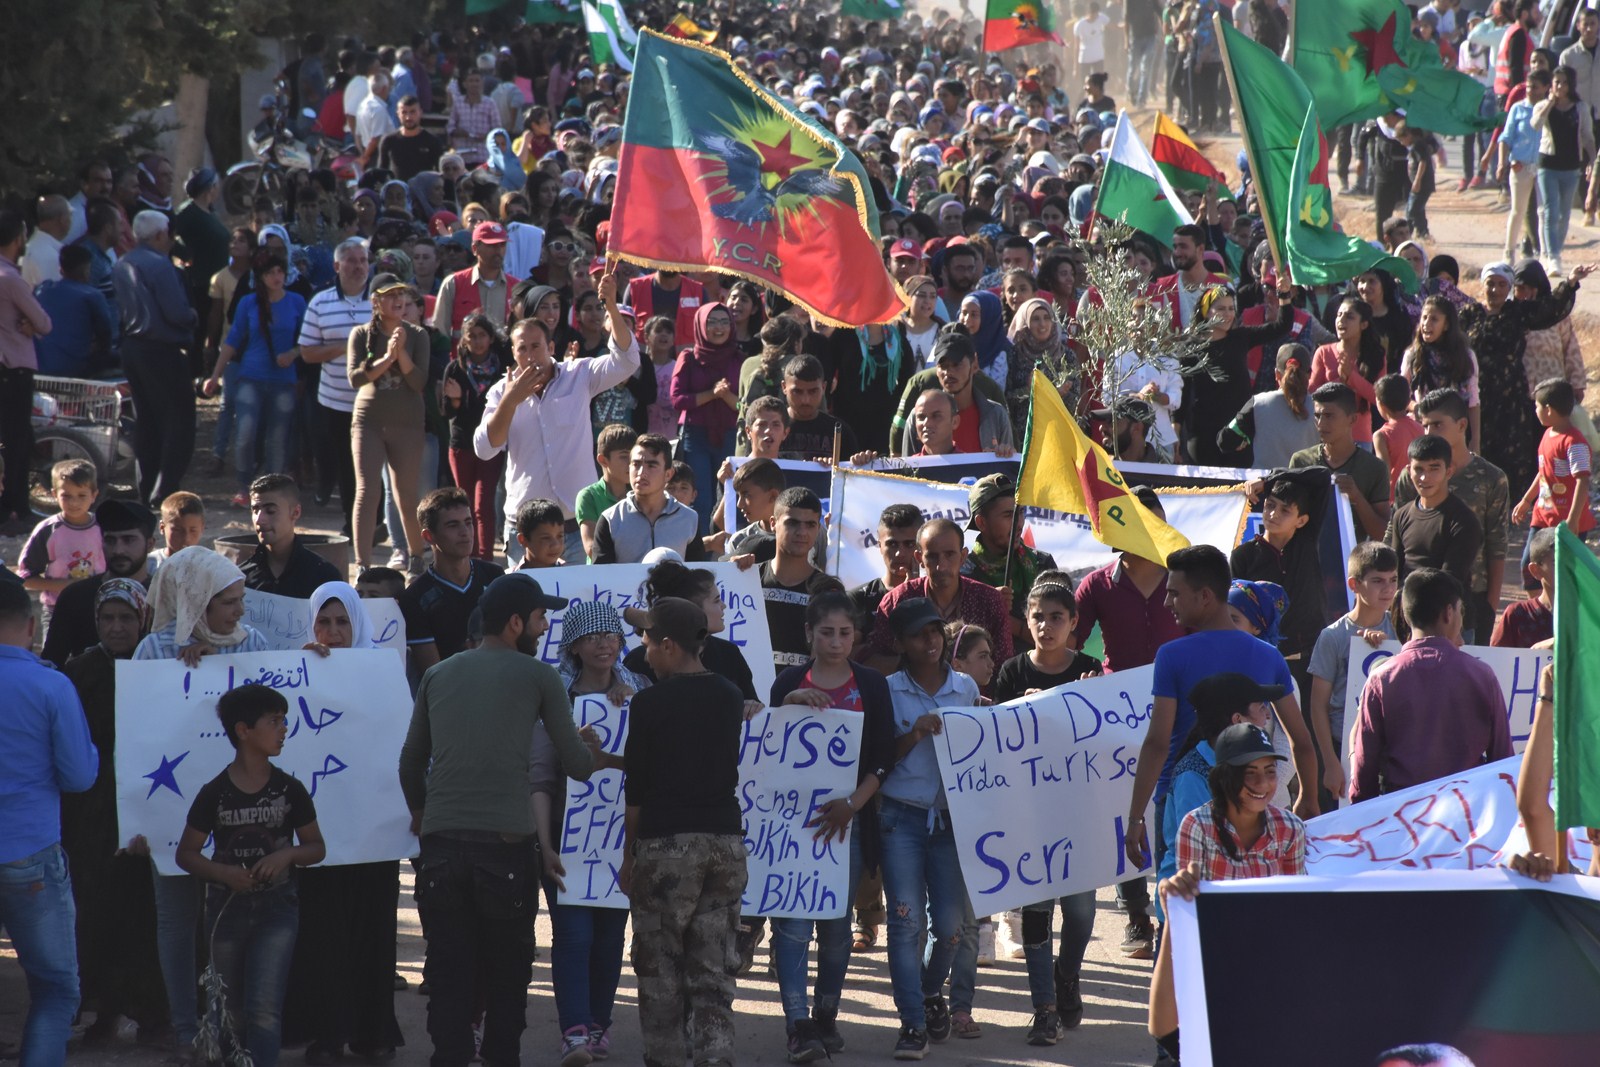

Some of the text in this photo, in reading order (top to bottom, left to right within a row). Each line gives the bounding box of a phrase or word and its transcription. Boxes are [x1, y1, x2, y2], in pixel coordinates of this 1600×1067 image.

[712, 237, 783, 275] Y.C.R
[1108, 745, 1137, 781] Se
[219, 806, 285, 826] CHAMPIONS
[233, 847, 266, 858] UEFA
[975, 831, 1073, 895] Serî
[757, 870, 837, 914] Bikin
